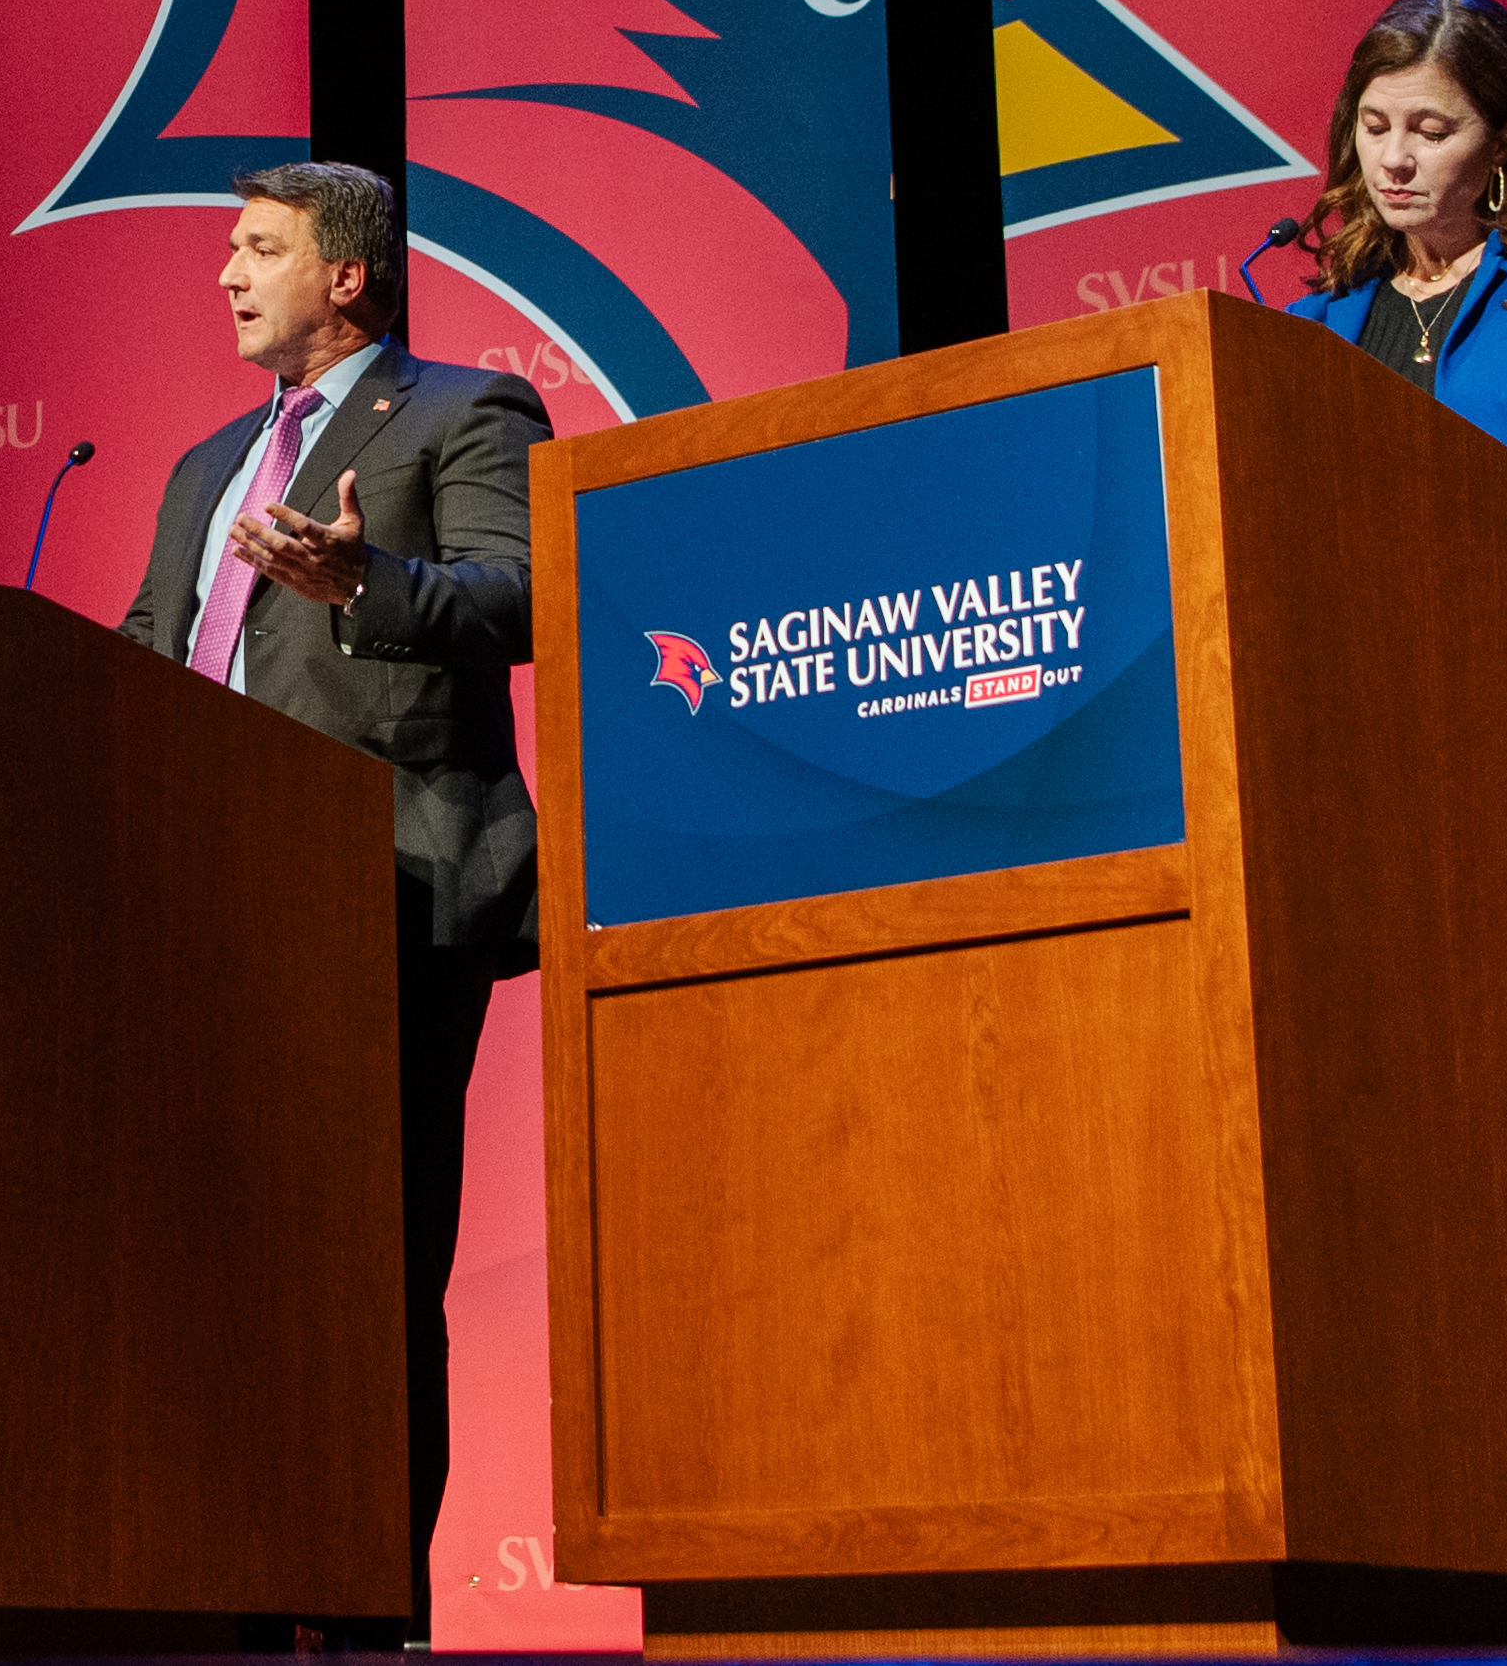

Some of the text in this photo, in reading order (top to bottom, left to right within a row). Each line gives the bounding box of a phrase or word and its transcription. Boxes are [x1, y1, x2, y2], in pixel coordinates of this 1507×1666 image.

[729, 559, 1082, 663] SAGINAW VALLEY
[729, 606, 1085, 708] STATE UNIVERSITY
[857, 665, 1083, 718] CARDINALS STAND OUT
